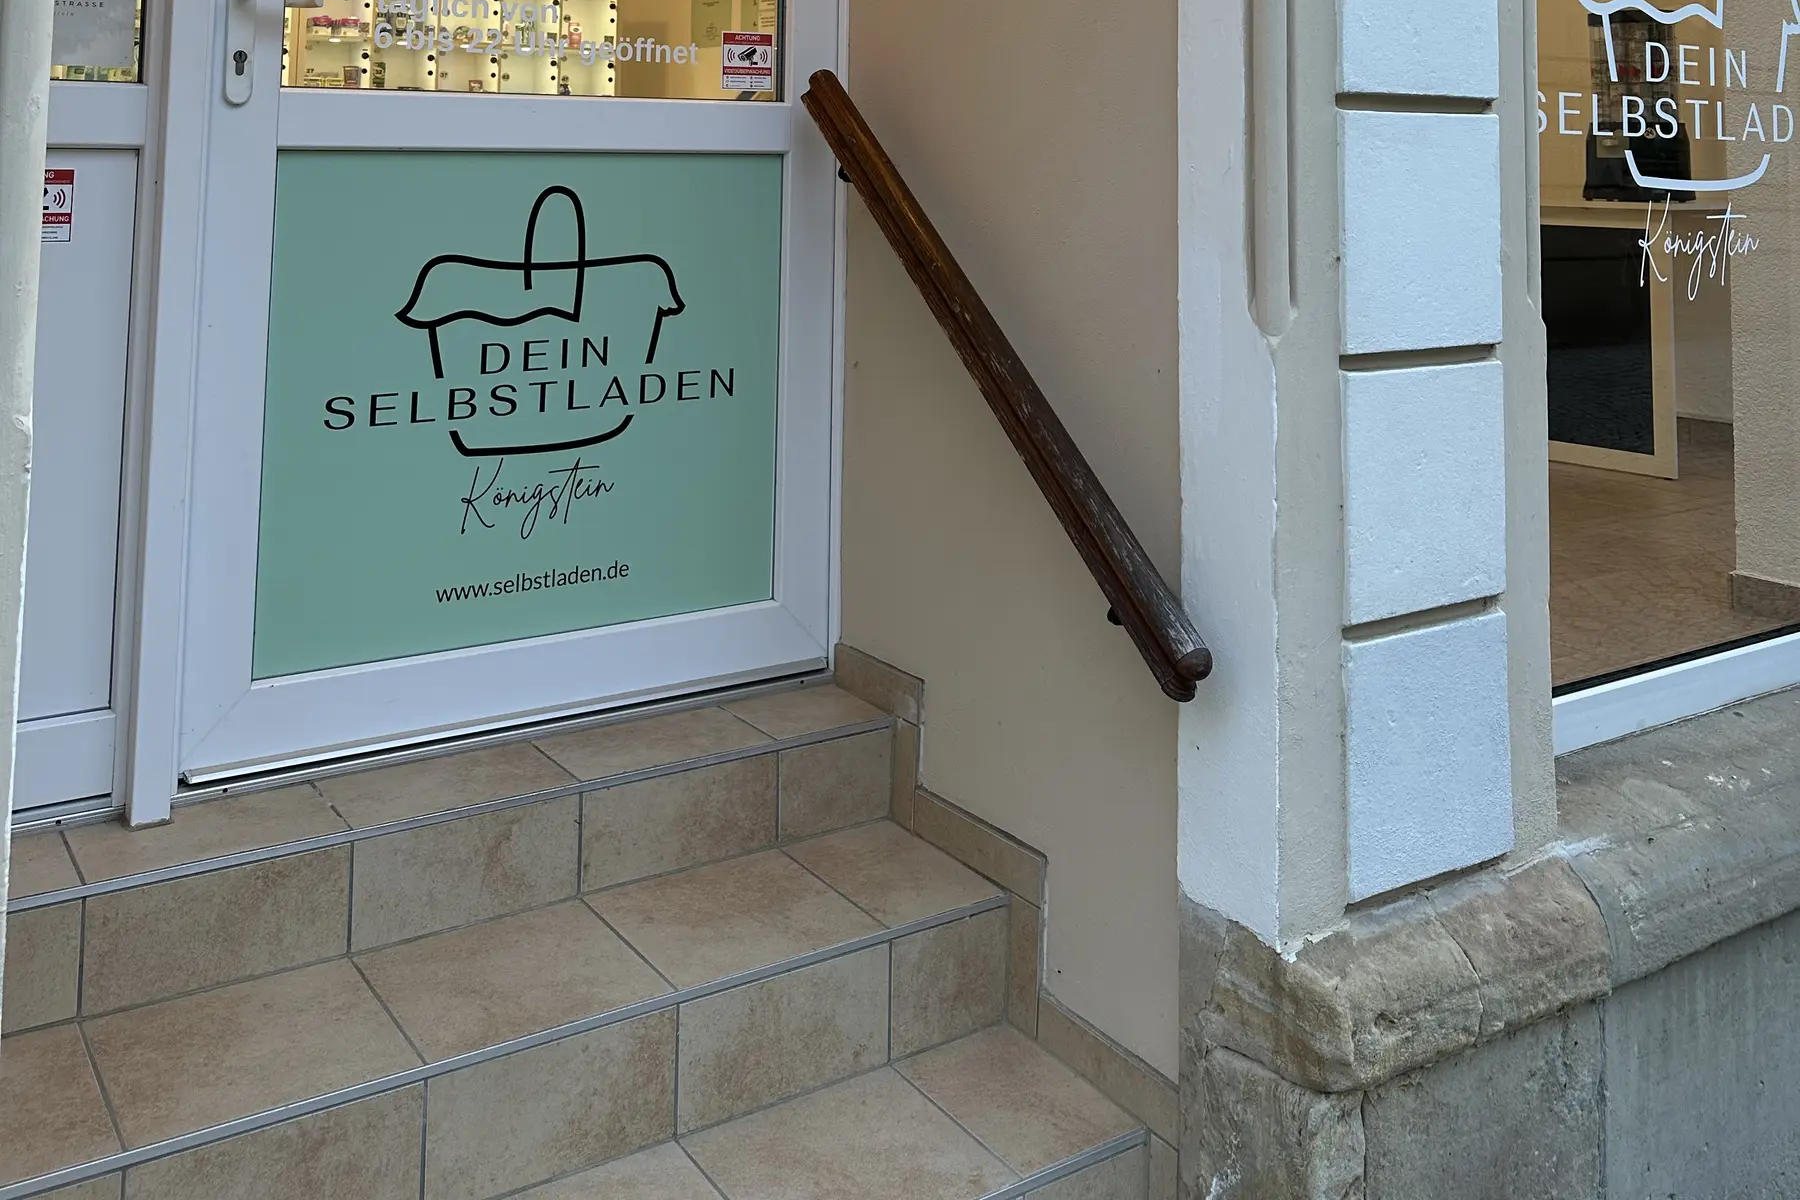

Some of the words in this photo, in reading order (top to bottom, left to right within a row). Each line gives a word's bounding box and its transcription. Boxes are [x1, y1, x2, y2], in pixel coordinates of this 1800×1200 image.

[501, 0, 558, 24] von
[374, 22, 393, 50] 6
[404, 22, 455, 52] bis
[466, 28, 503, 55] 22
[515, 31, 570, 57] Uhr
[579, 36, 699, 66] geöffnet
[1645, 41, 1746, 89] DEIN
[1639, 192, 1759, 302] Königstein
[479, 335, 610, 375] DEIN
[323, 367, 736, 431] SELBSTLADEN
[460, 457, 615, 540] Königstein
[435, 559, 630, 604] www.selbstladen.de
